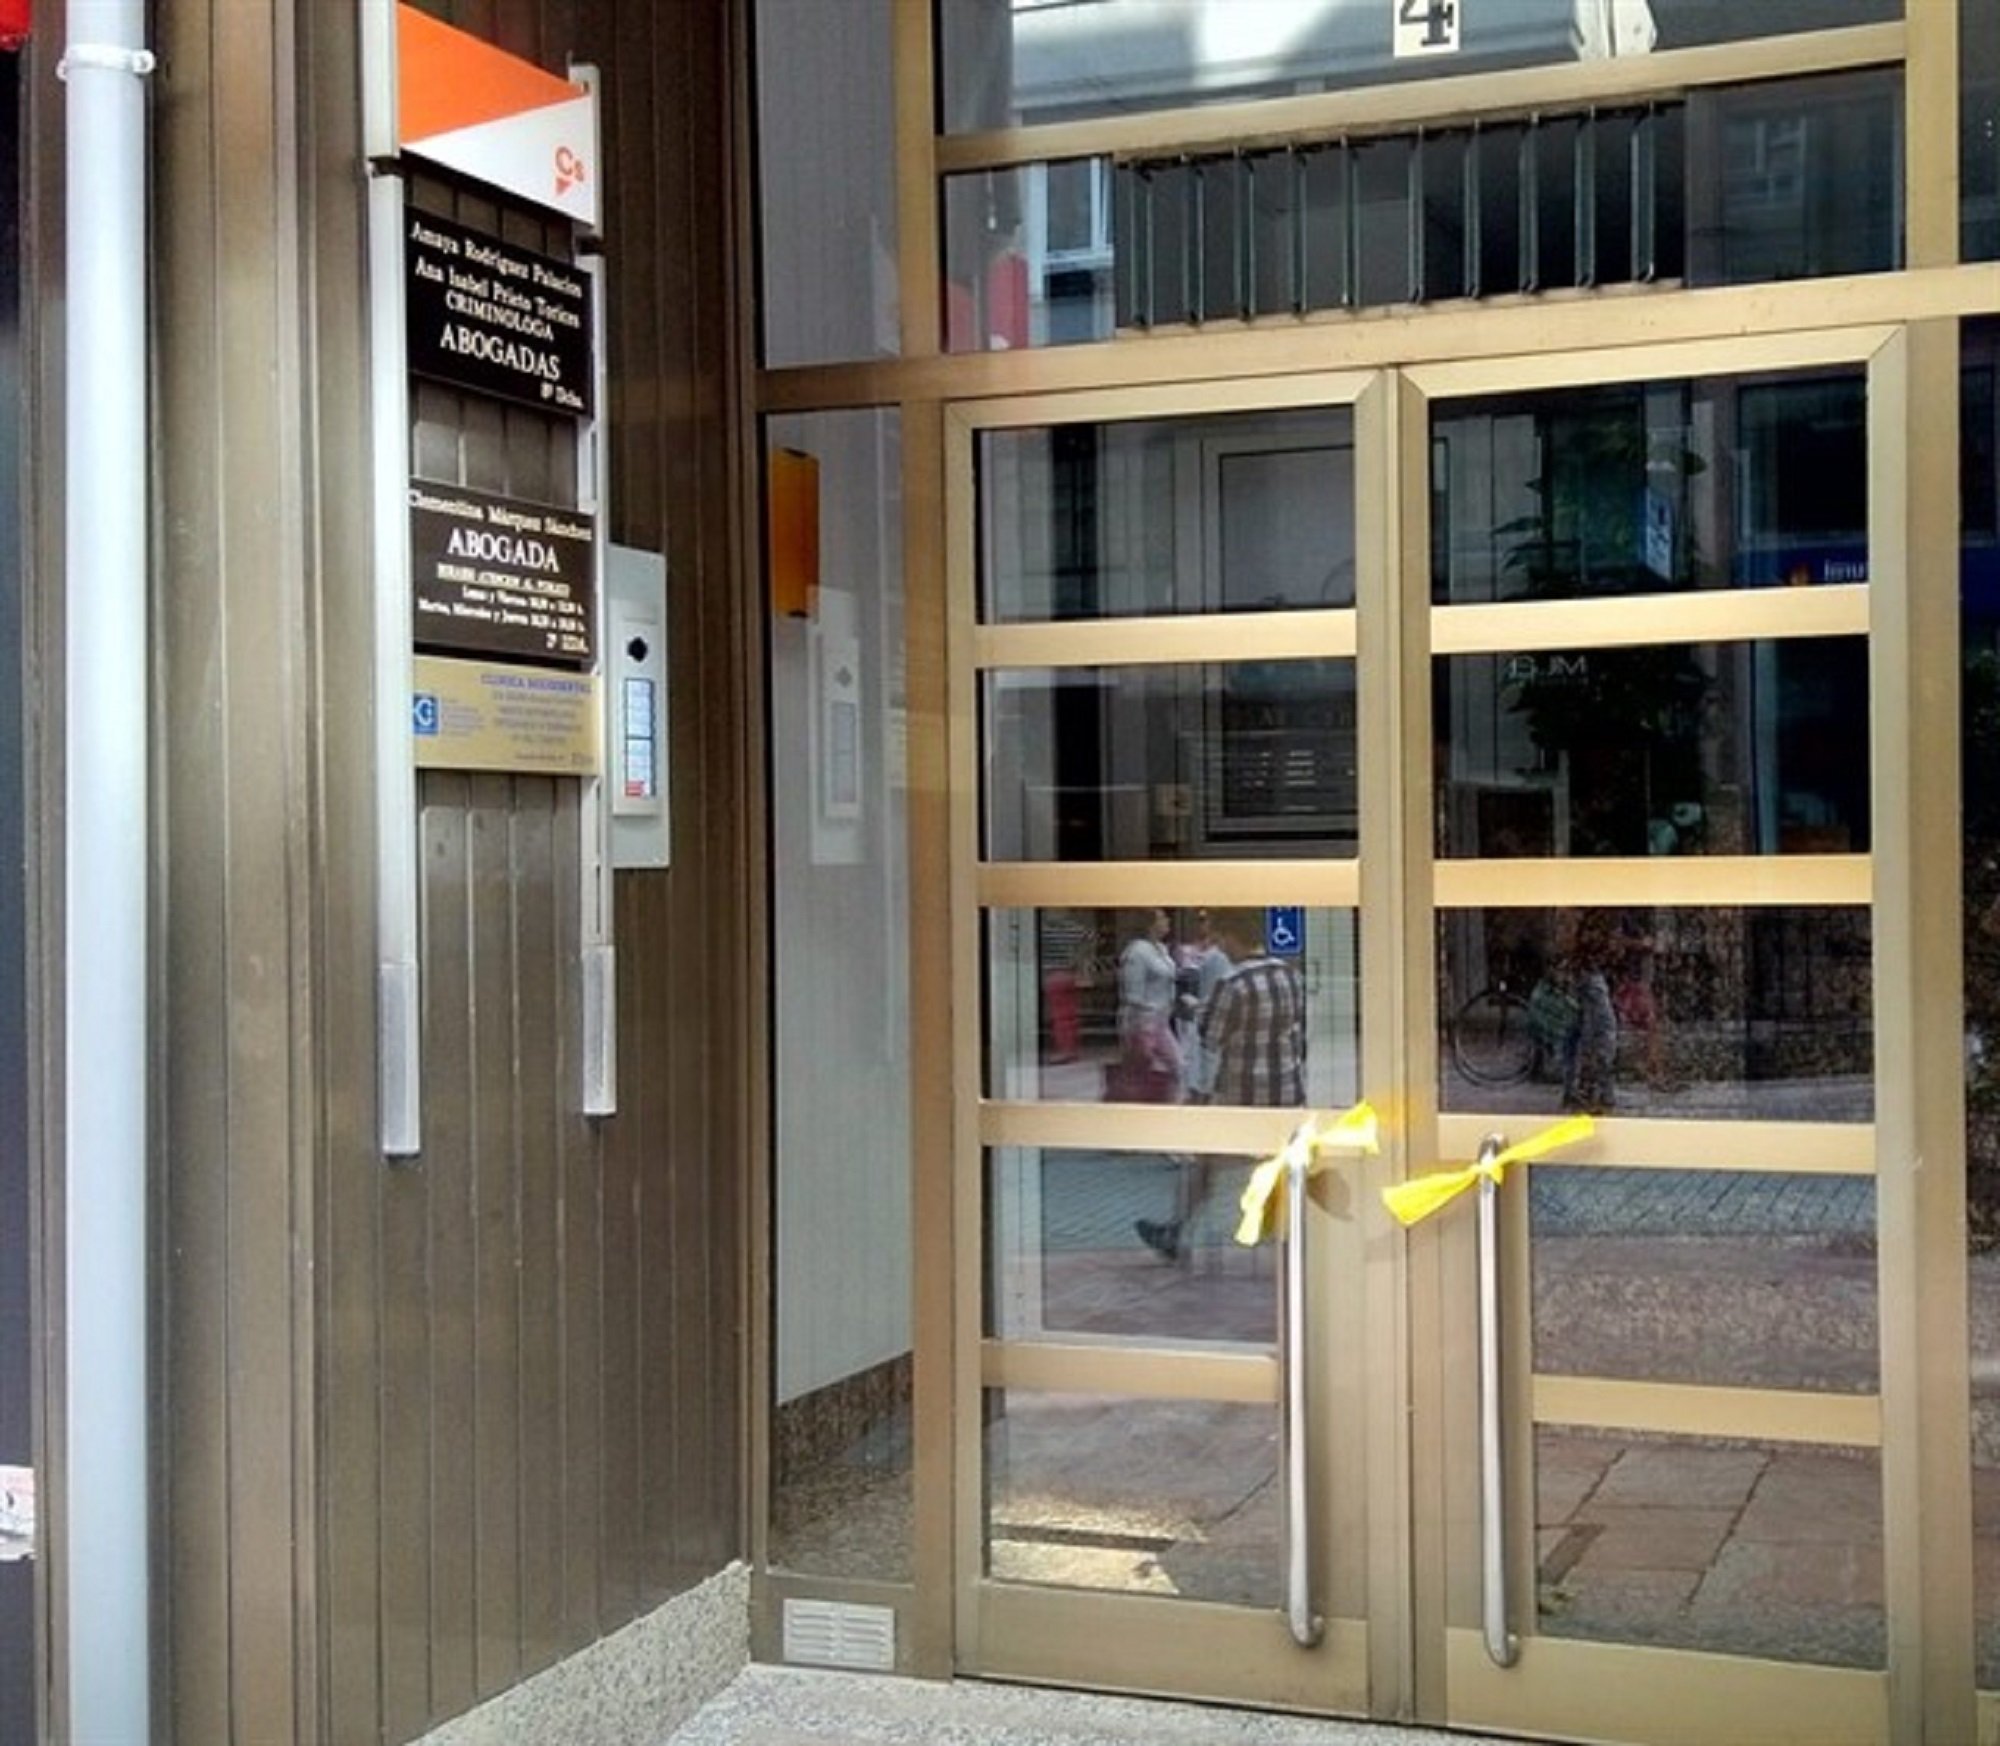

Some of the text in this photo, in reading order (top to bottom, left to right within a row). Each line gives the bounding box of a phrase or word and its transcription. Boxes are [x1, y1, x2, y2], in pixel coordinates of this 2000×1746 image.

[1399, 0, 1453, 47] 4
[415, 256, 444, 282] Ana
[440, 322, 561, 381] ABOGADAS
[447, 527, 560, 573] ABOGADA
